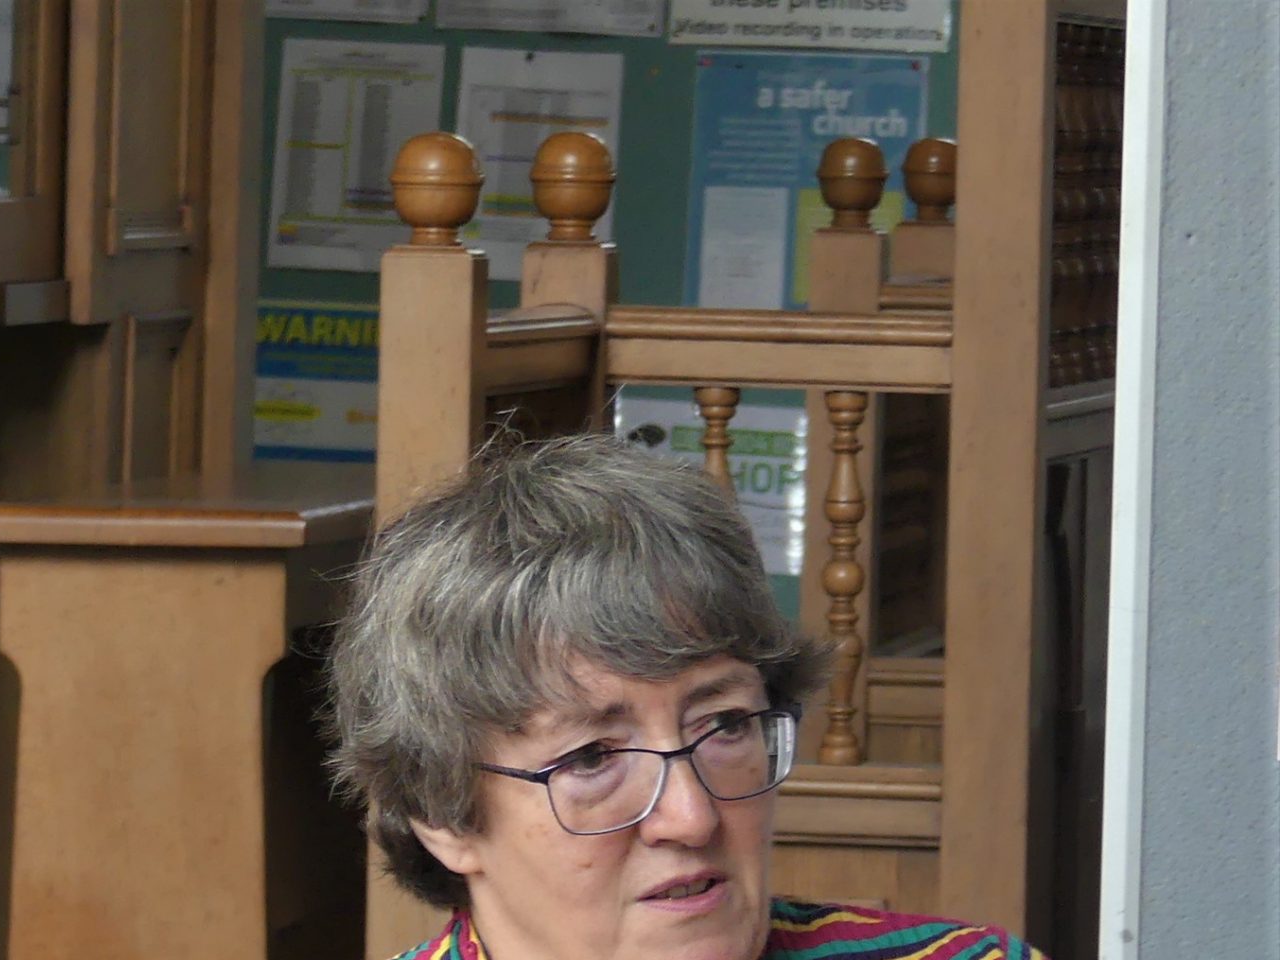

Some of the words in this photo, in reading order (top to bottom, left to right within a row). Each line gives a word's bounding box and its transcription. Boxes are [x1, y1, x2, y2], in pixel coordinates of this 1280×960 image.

[672, 19, 727, 37] Video
[733, 23, 822, 40] recording
[828, 25, 845, 37] in
[849, 26, 943, 42] operation
[757, 87, 774, 108] a
[780, 80, 853, 110] safer
[814, 108, 908, 138] church
